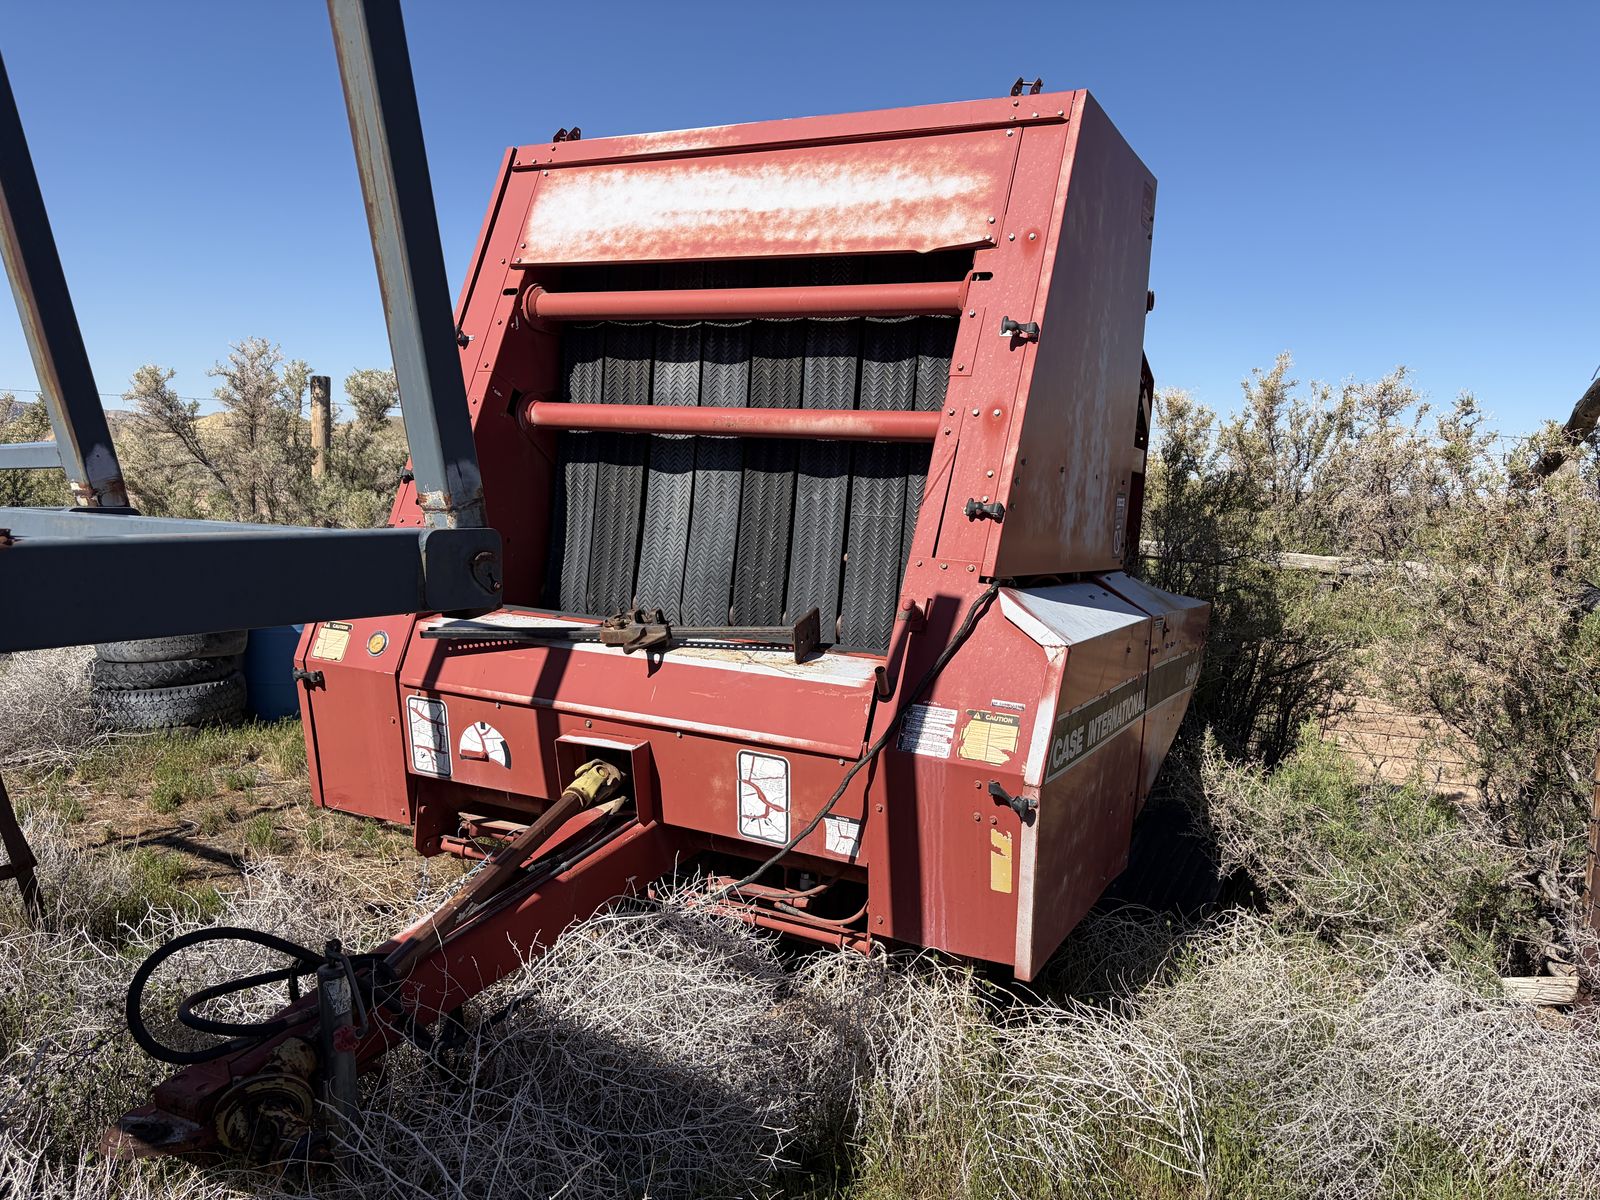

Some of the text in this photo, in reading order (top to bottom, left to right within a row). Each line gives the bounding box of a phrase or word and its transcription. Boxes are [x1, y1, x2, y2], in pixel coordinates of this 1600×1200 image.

[985, 714, 1013, 724] CAUTION
[1052, 725, 1084, 769] CASE
[1087, 689, 1146, 747] INTERNATIONAL
